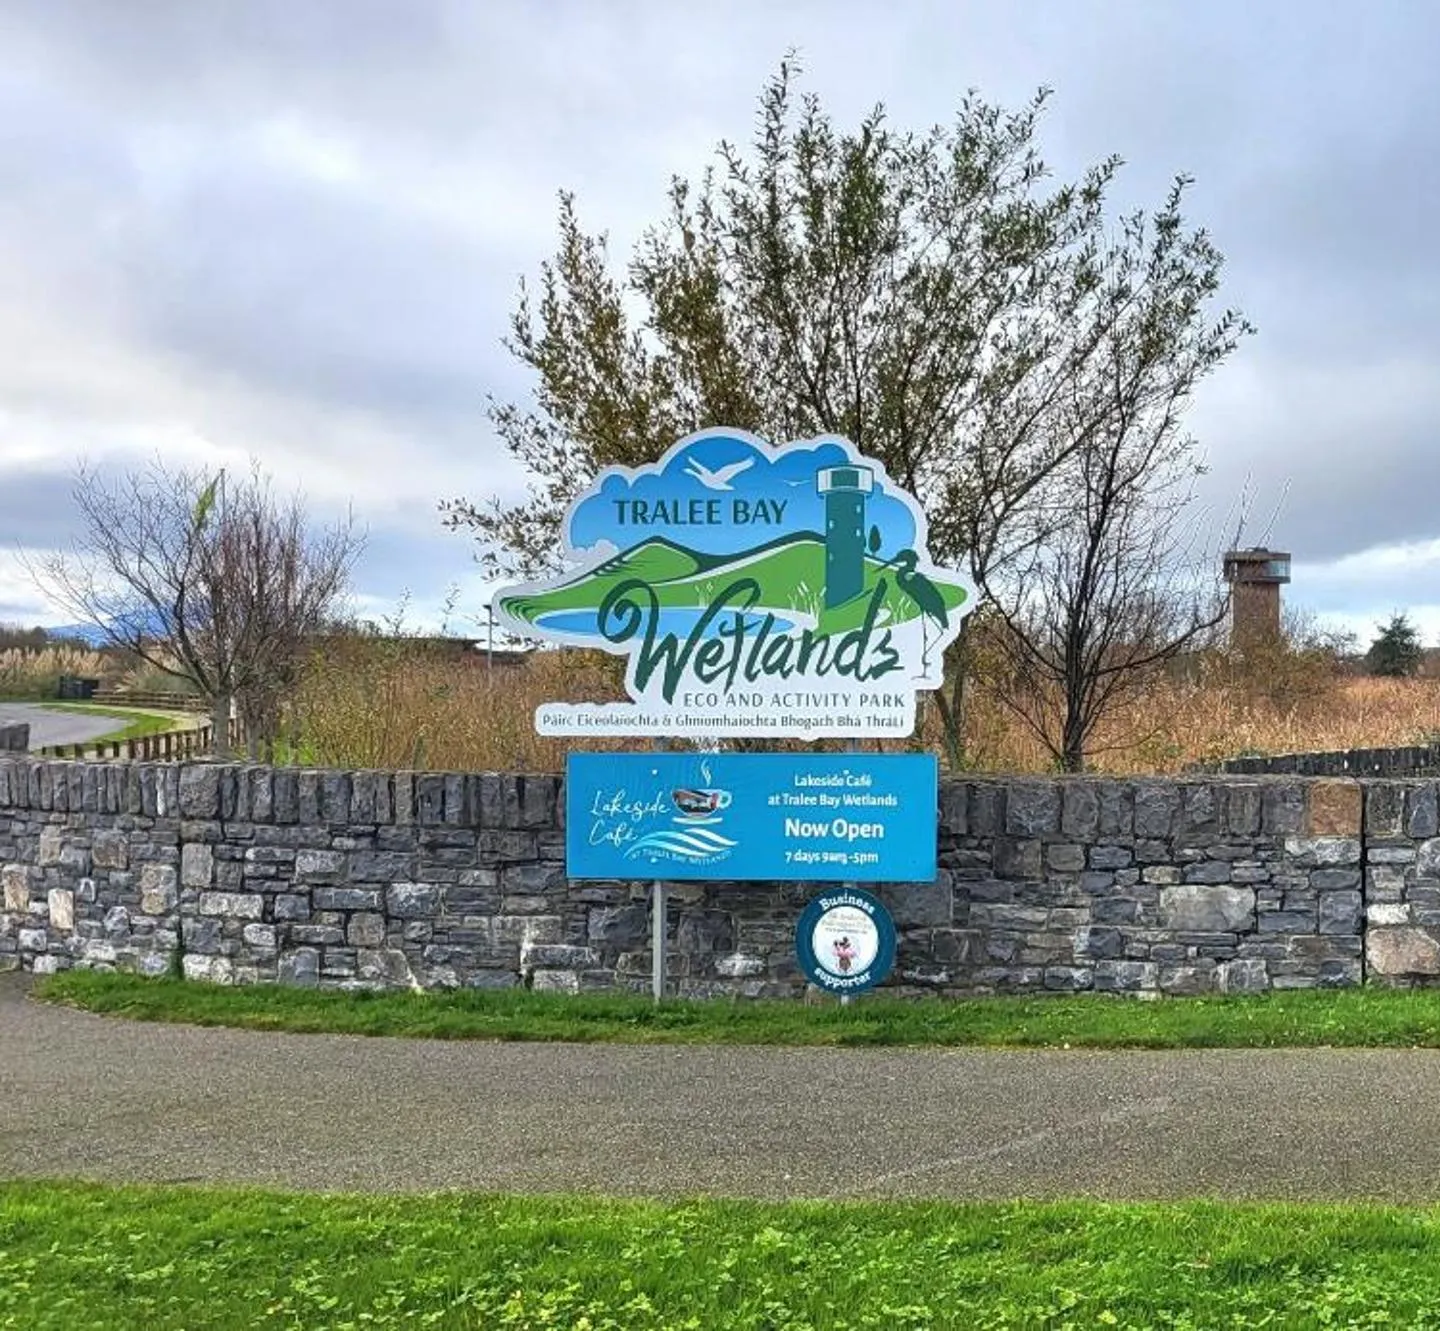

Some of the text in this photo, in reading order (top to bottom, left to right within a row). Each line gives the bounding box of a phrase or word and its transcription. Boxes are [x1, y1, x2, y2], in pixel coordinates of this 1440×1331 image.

[612, 499, 787, 525] TRALEE BAY
[597, 577, 905, 705] Wetlands
[684, 692, 905, 707] ECO AND ACTIVITY PARK
[795, 774, 844, 787] Lakeside
[591, 789, 671, 821] Lakeside
[768, 794, 898, 808] at Tralee Bay Wetlands
[785, 818, 885, 841] Now Open
[785, 852, 792, 864] 7
[794, 850, 820, 865] days
